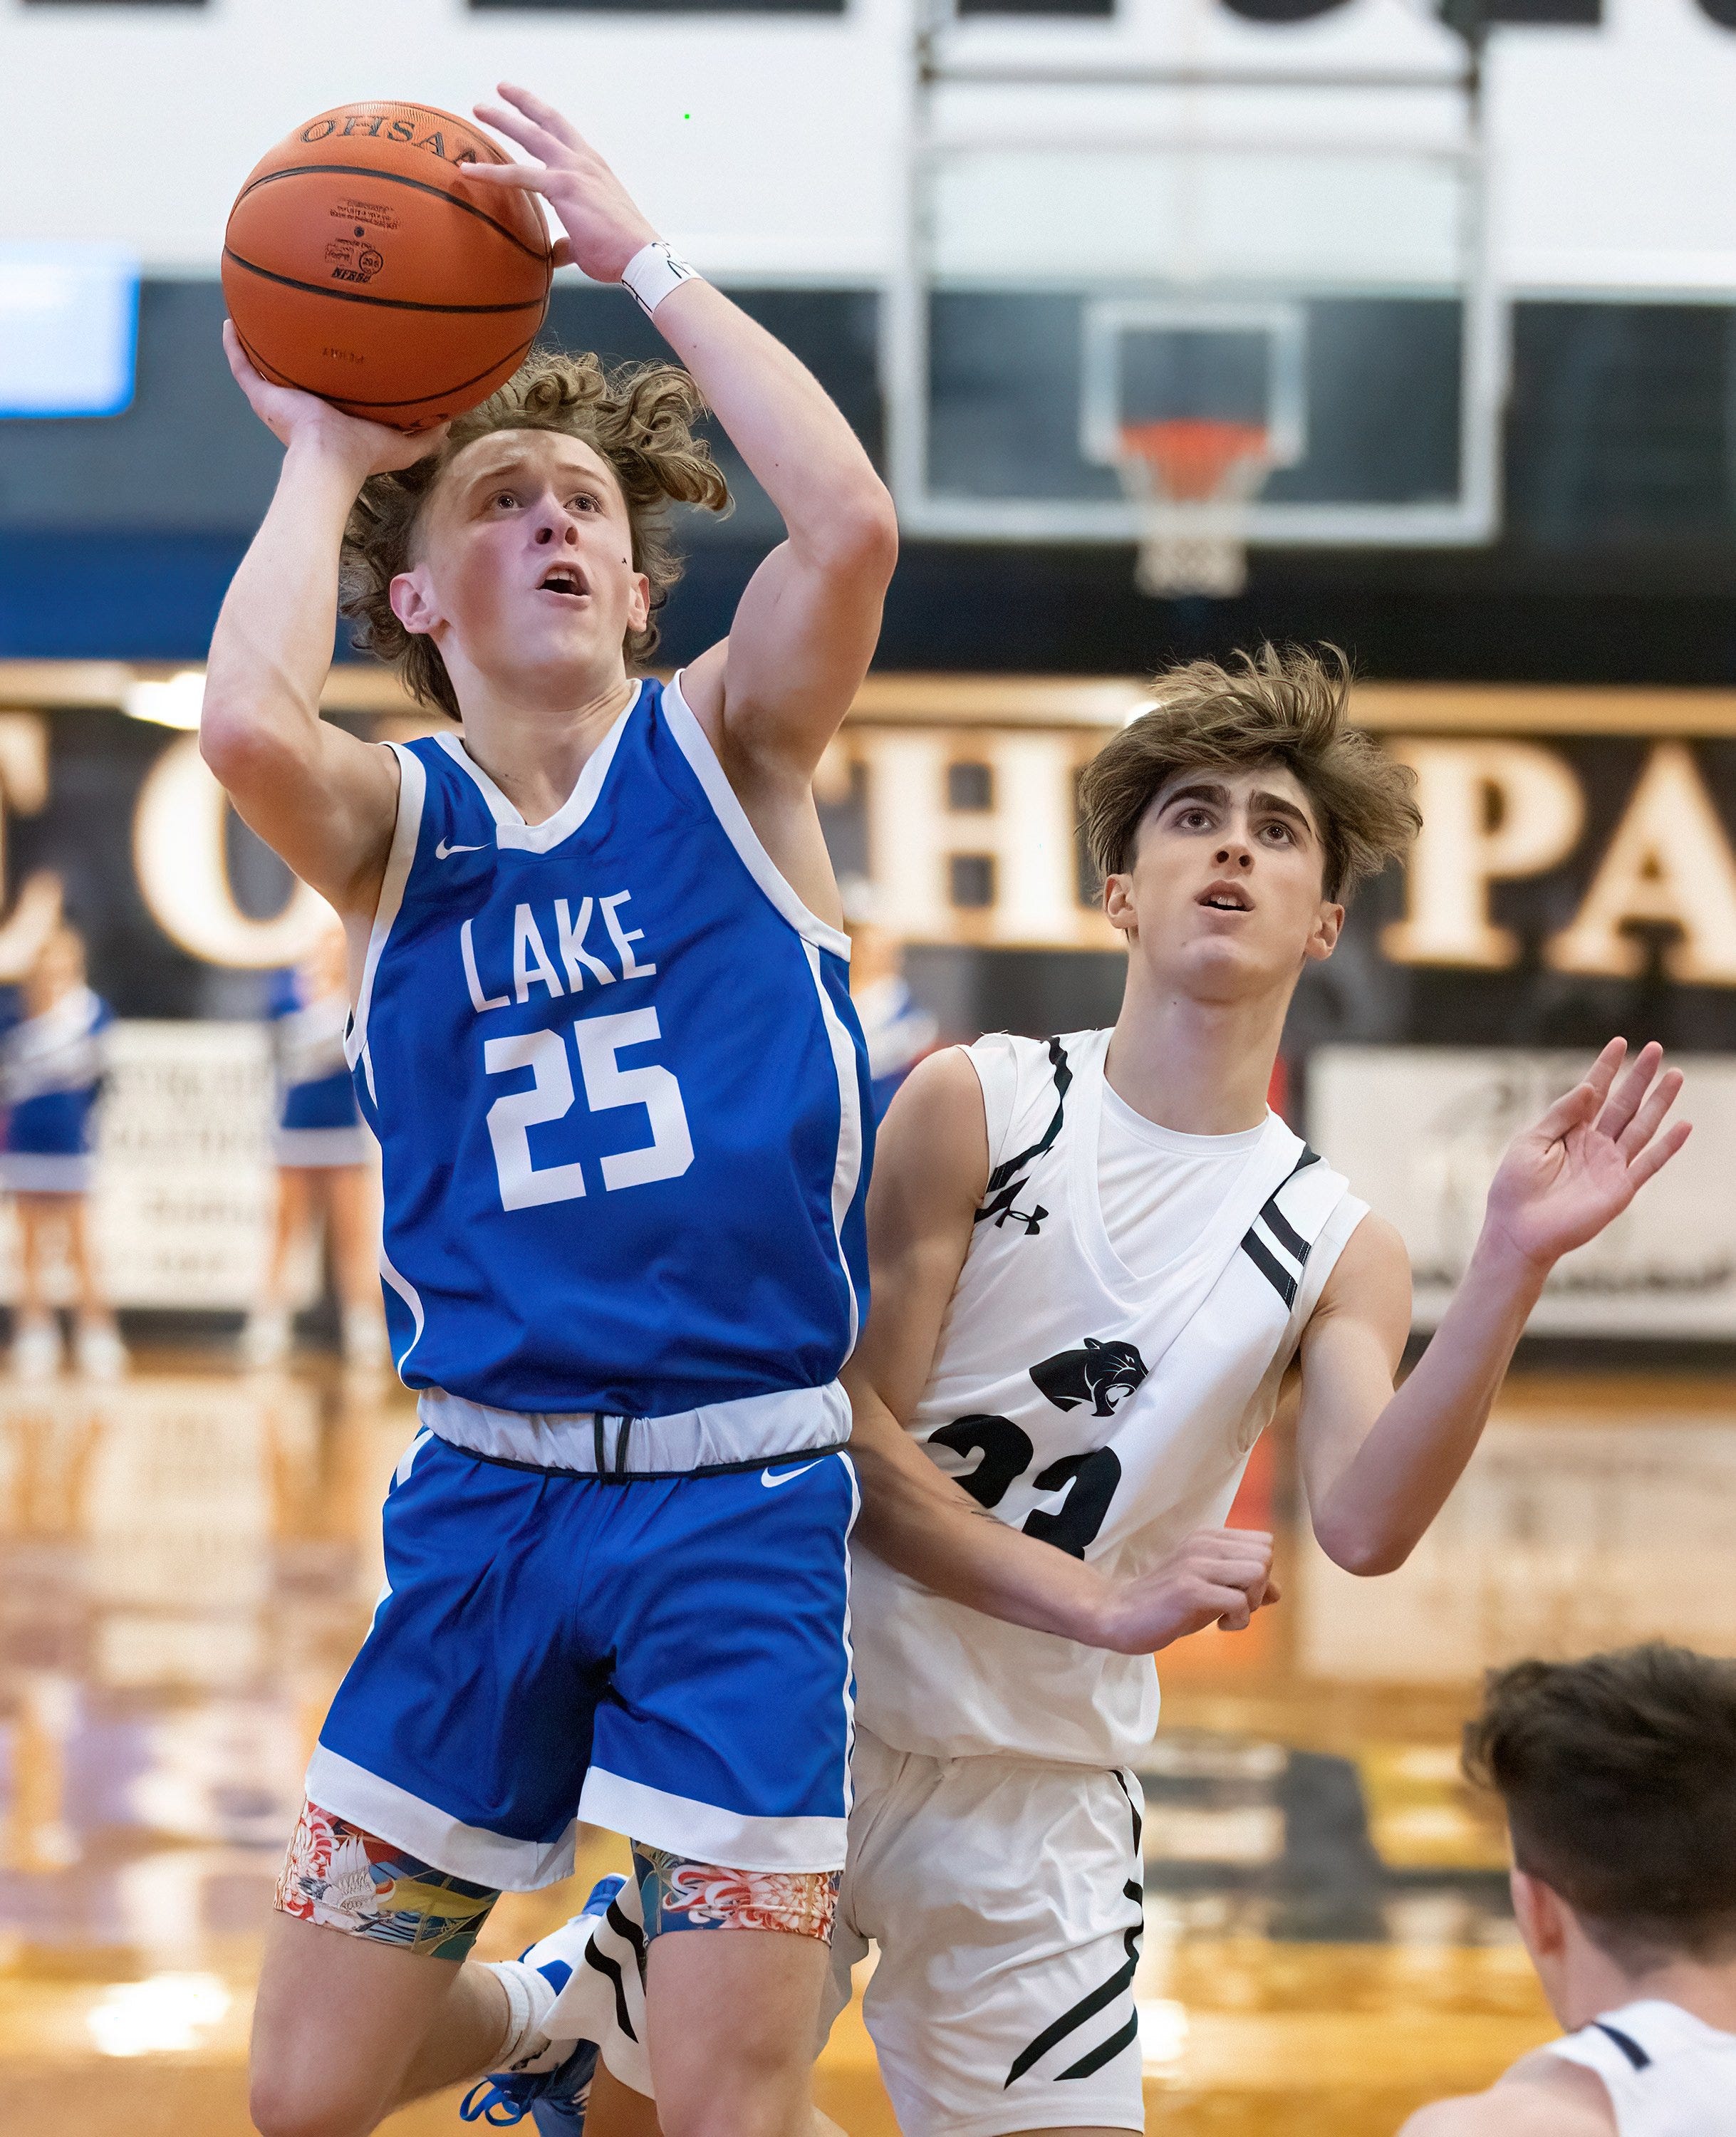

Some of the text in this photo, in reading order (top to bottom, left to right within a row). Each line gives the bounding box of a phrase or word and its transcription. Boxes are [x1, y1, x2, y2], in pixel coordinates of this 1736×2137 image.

[300, 115, 477, 168] OHSAA
[461, 889, 657, 1013] LAKE
[484, 1006, 695, 1212] 25
